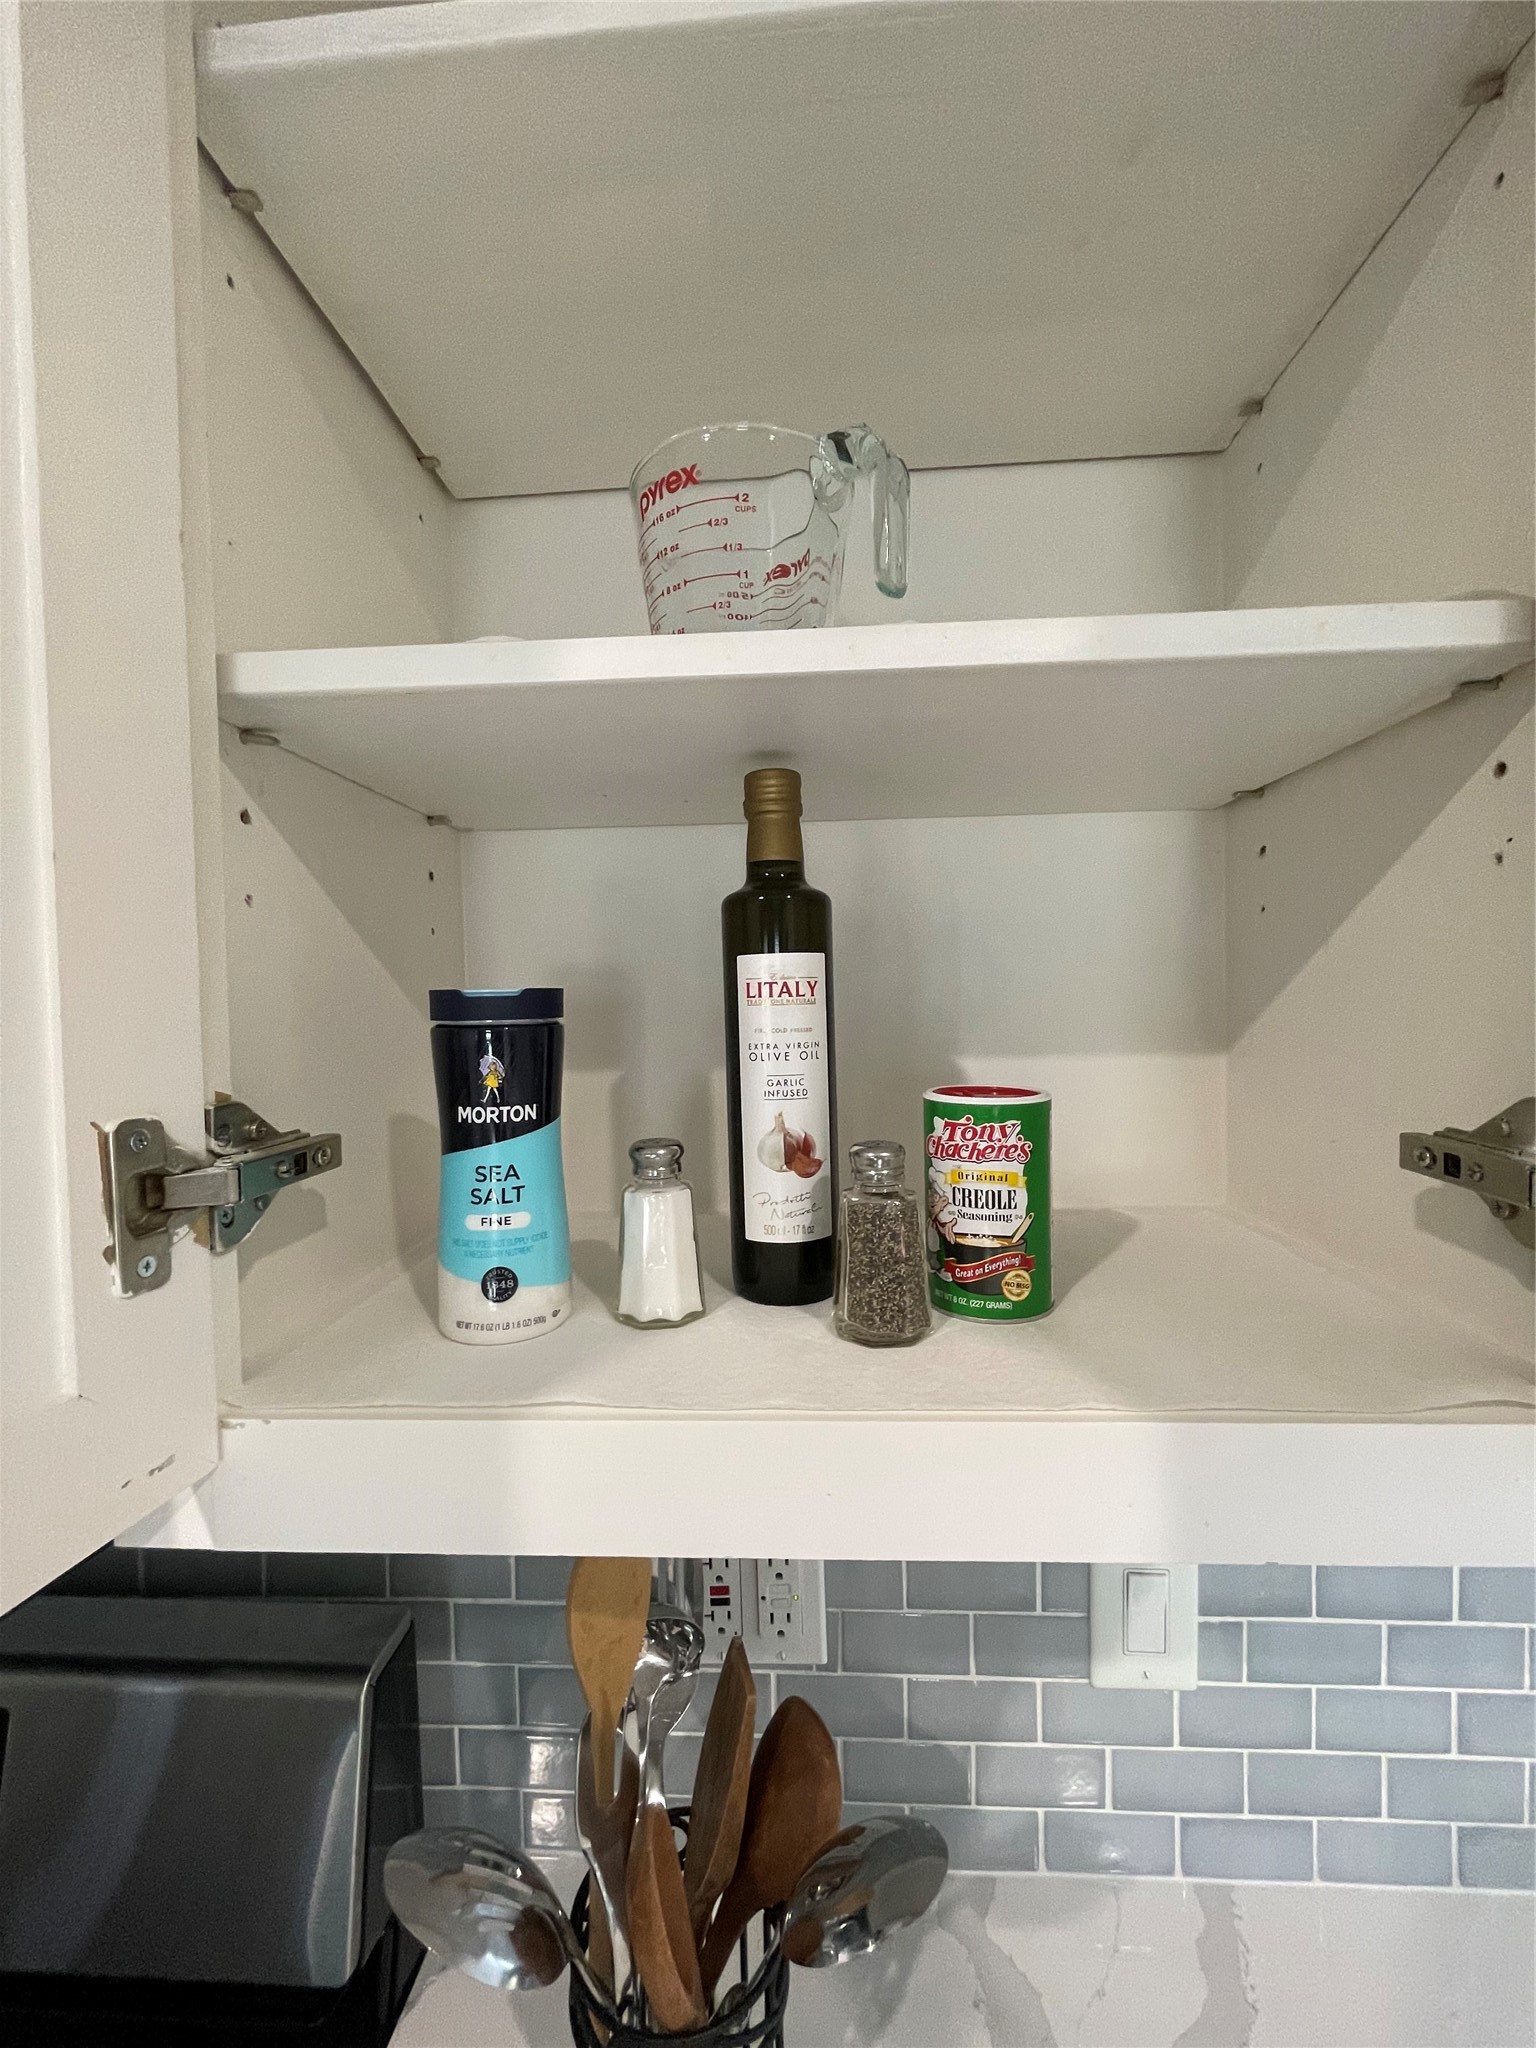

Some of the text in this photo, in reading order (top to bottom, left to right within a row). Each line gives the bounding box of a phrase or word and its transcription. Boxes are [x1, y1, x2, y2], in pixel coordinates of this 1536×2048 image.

[639, 463, 698, 522] pyrex
[741, 492, 750, 502] 2
[734, 505, 757, 513] CUPS
[655, 508, 676, 524] 16 oz
[713, 517, 729, 526] 2/3
[659, 543, 680, 558] 12 oz
[728, 542, 743, 551] 1/3
[743, 569, 749, 579] 1
[672, 583, 681, 592] oz
[739, 581, 754, 589] CUP
[718, 601, 731, 609] 2/3
[746, 980, 818, 999] LITALY
[748, 1041, 820, 1051] EXTRA VIRGIN
[749, 1050, 820, 1062] OLIVE OIL
[766, 1078, 805, 1088] GARLIC
[764, 1088, 808, 1099] INFUSED
[457, 1103, 537, 1124] MORTON
[942, 1117, 1021, 1144] Tony
[474, 1164, 521, 1183] SEA
[957, 1172, 1009, 1183] Original
[470, 1184, 526, 1205] SALT
[952, 1186, 1017, 1211] CREOLE
[480, 1215, 512, 1227] FINE
[956, 1209, 1013, 1224] Seasoning
[763, 1224, 776, 1236] 500
[792, 1224, 801, 1235] 17
[955, 1267, 974, 1279] Great
[975, 1267, 984, 1275] on
[486, 1279, 515, 1290] 1848
[970, 1299, 984, 1308] (227
[986, 1301, 1013, 1310] GRAMS)
[502, 1321, 511, 1331] LB
